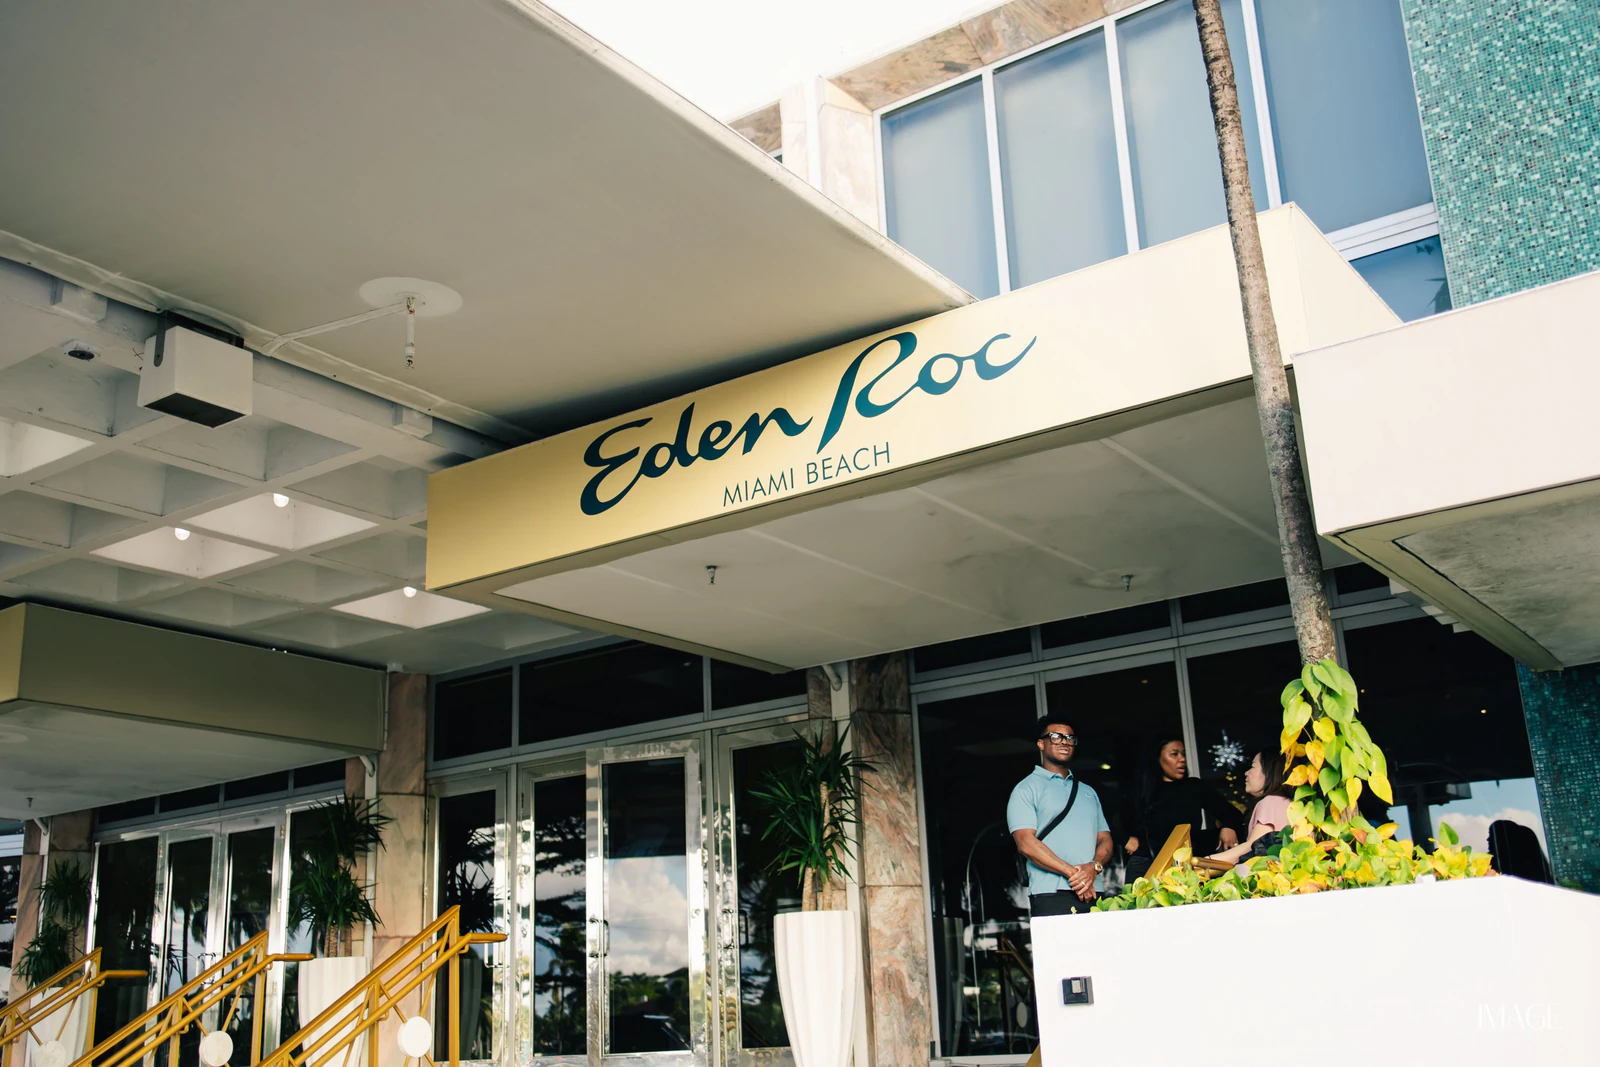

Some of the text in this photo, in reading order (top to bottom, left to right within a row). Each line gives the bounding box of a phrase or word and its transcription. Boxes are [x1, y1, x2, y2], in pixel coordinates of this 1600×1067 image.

[580, 331, 1037, 515] Eden Roc
[723, 442, 891, 507] MIAMI BEACH
